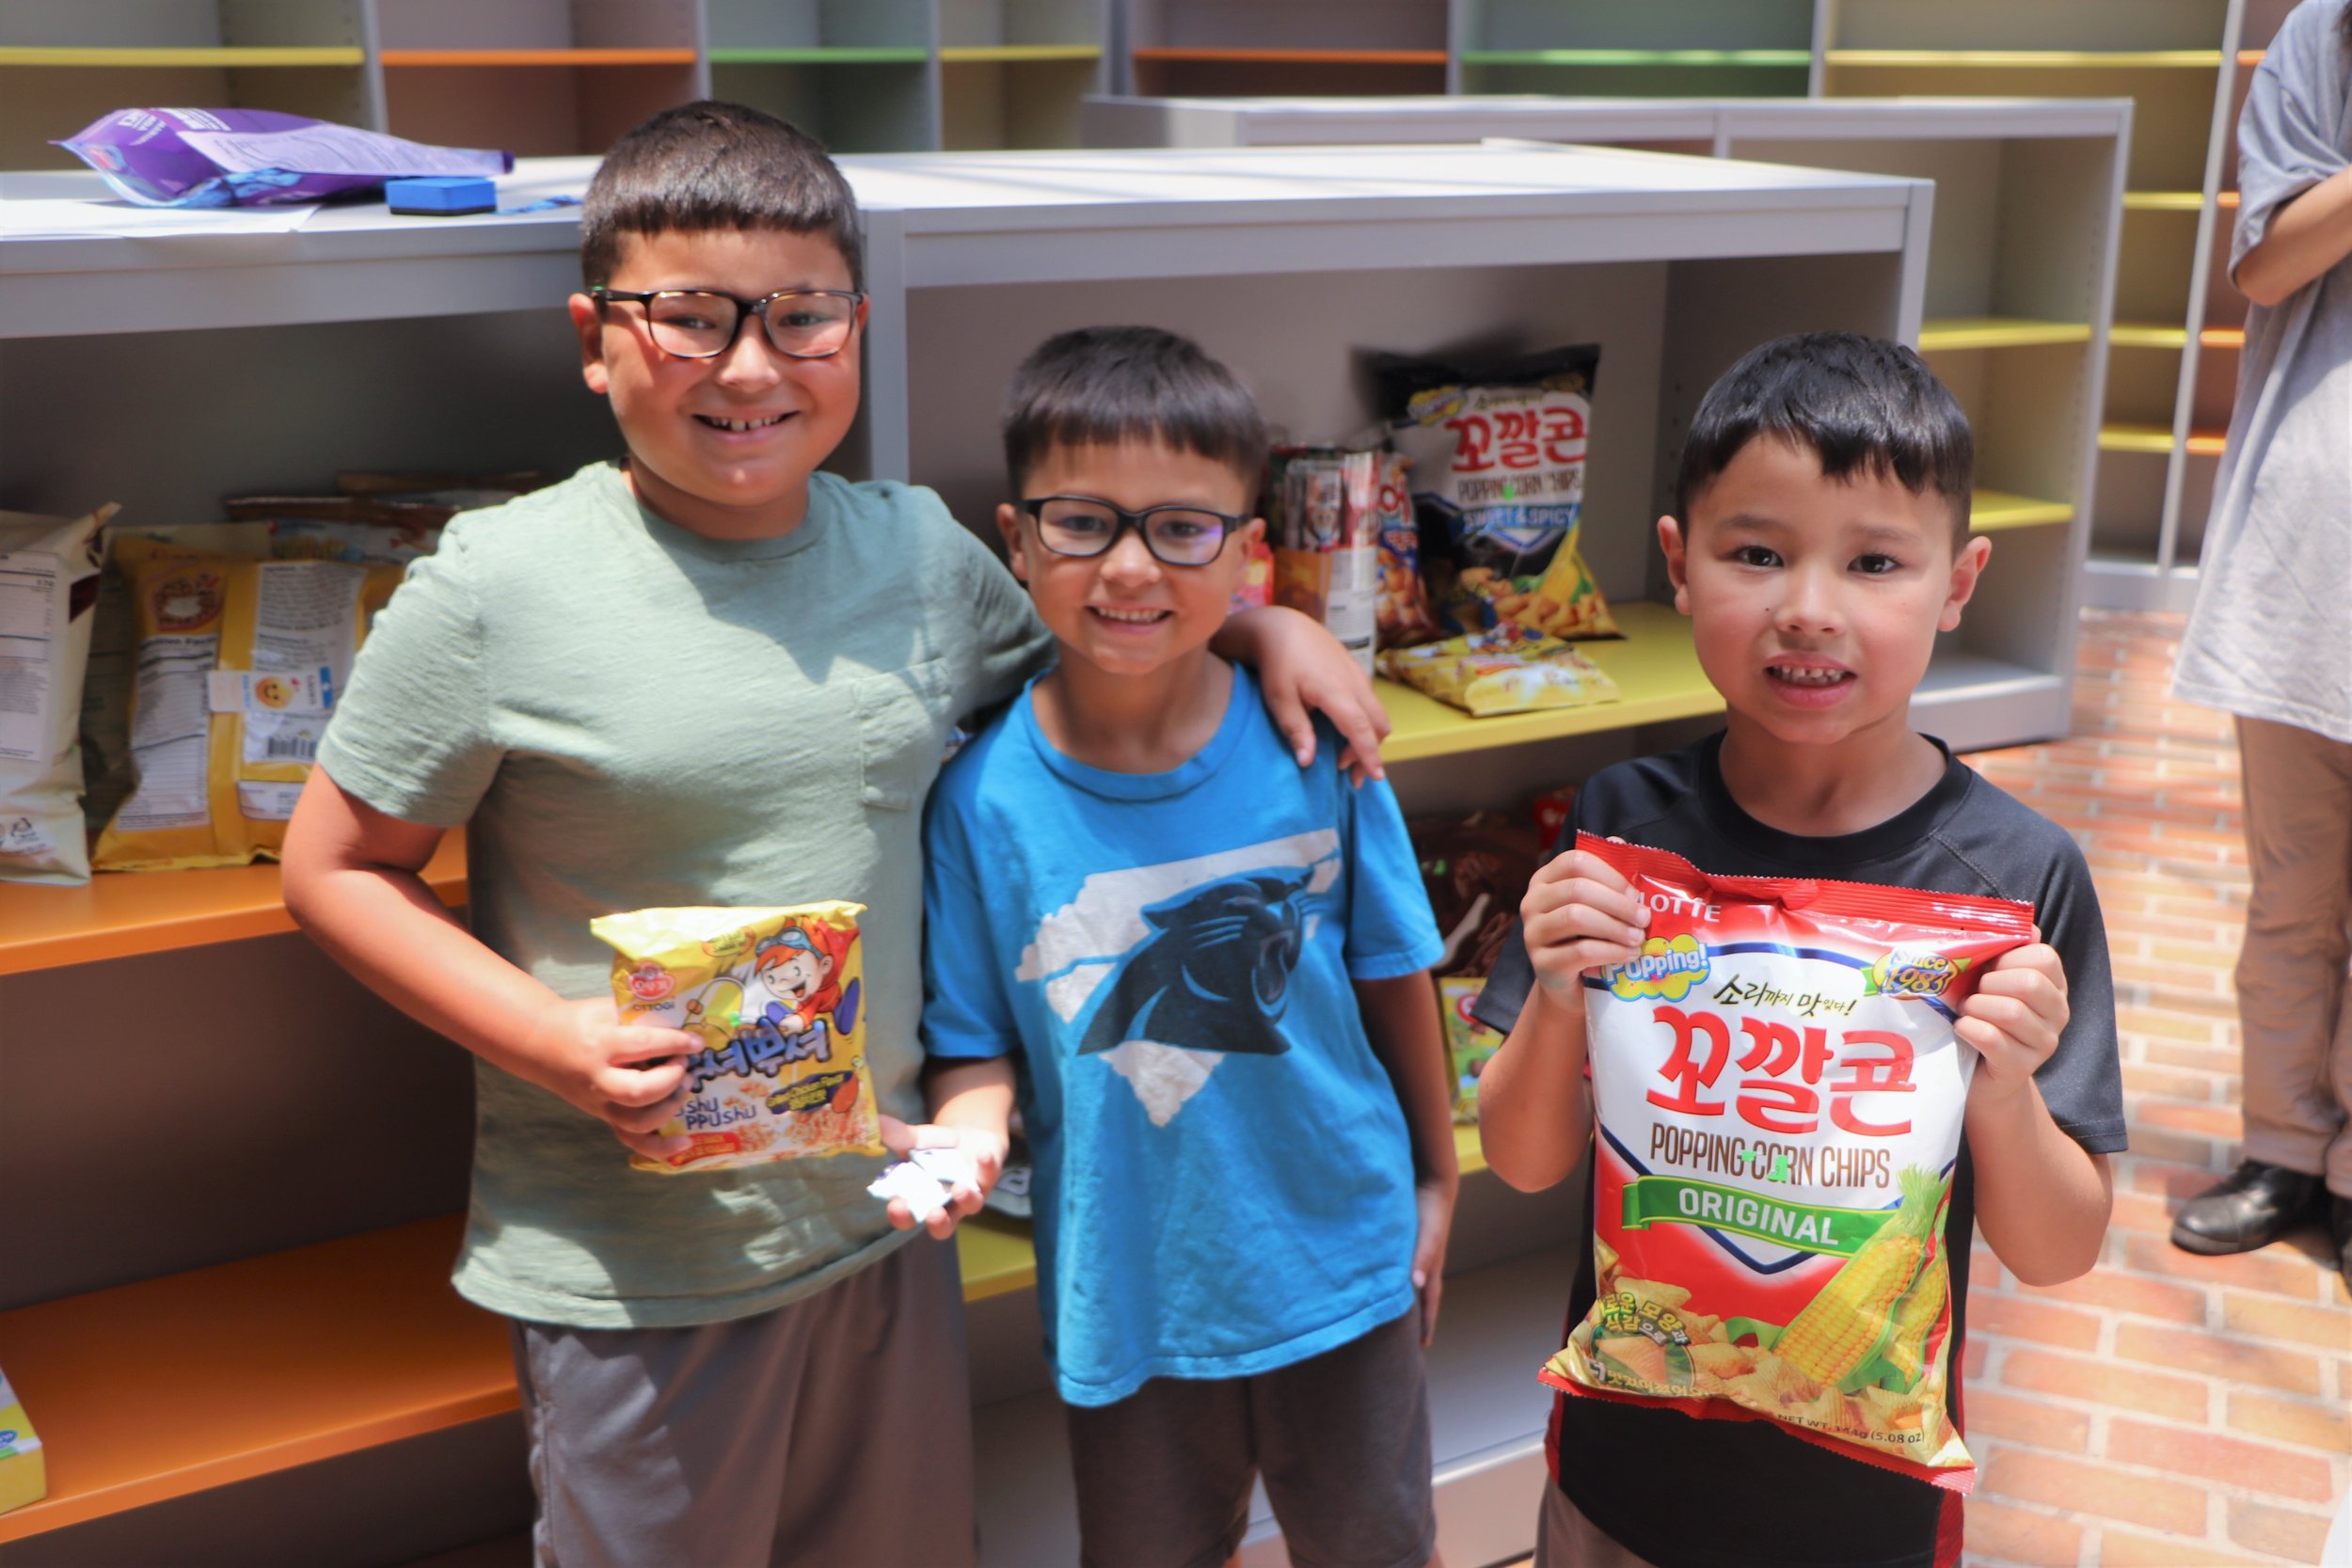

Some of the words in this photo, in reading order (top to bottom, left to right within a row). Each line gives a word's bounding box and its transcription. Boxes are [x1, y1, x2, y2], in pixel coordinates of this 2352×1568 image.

[1444, 406, 1588, 474] 꼬깔콘
[1529, 507, 1574, 525] SPICY
[1637, 892, 1722, 923] LOTTE
[1604, 942, 1708, 982] Popping!
[1884, 966, 1950, 992] 1983
[632, 1001, 675, 1012] OTTOGI
[1712, 973, 1795, 1007] 소리까지
[1797, 992, 1858, 1017] 맛있다!
[1646, 1006, 1917, 1137] 꼬깔콘
[1650, 1122, 1745, 1178] POPPING
[1751, 1139, 1814, 1186] CORN
[1820, 1146, 1891, 1189] CHIPS
[1678, 1188, 1839, 1245] ORIGINAL
[1639, 1300, 1692, 1346] 모양과
[1777, 1414, 1804, 1424] NET
[1807, 1418, 1832, 1431] WT.
[1836, 1425, 1868, 1440] 144g
[1870, 1431, 1905, 1444] (5.08
